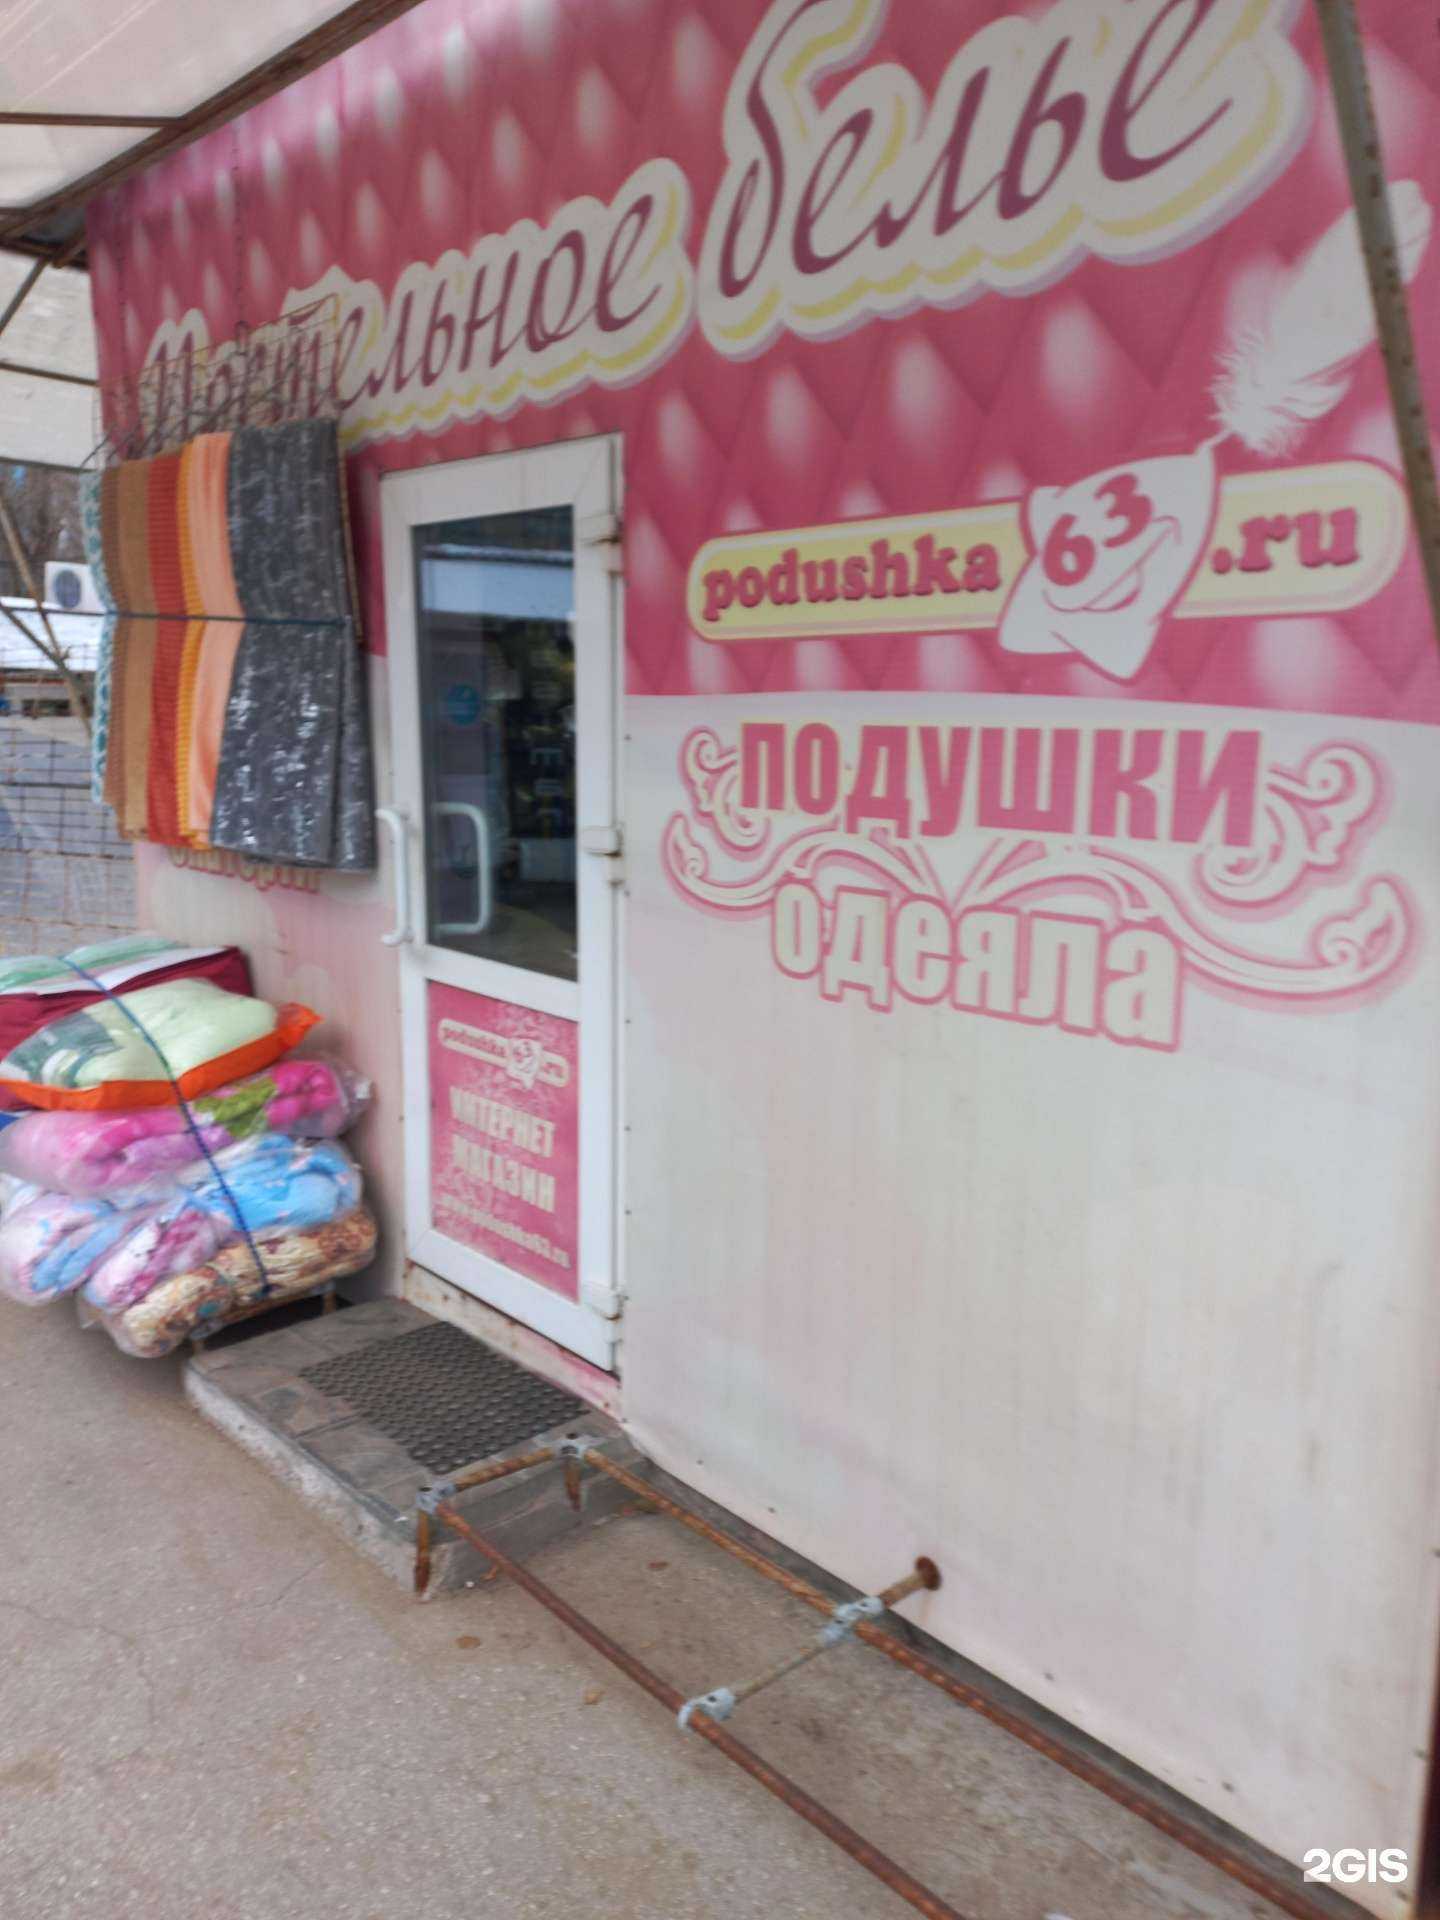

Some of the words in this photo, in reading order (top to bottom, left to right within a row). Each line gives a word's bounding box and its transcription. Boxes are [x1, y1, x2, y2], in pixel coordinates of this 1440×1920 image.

[718, 0, 1234, 298] белье
[740, 722, 1263, 848] ПОДУШКИ
[771, 883, 1182, 1053] одеяла
